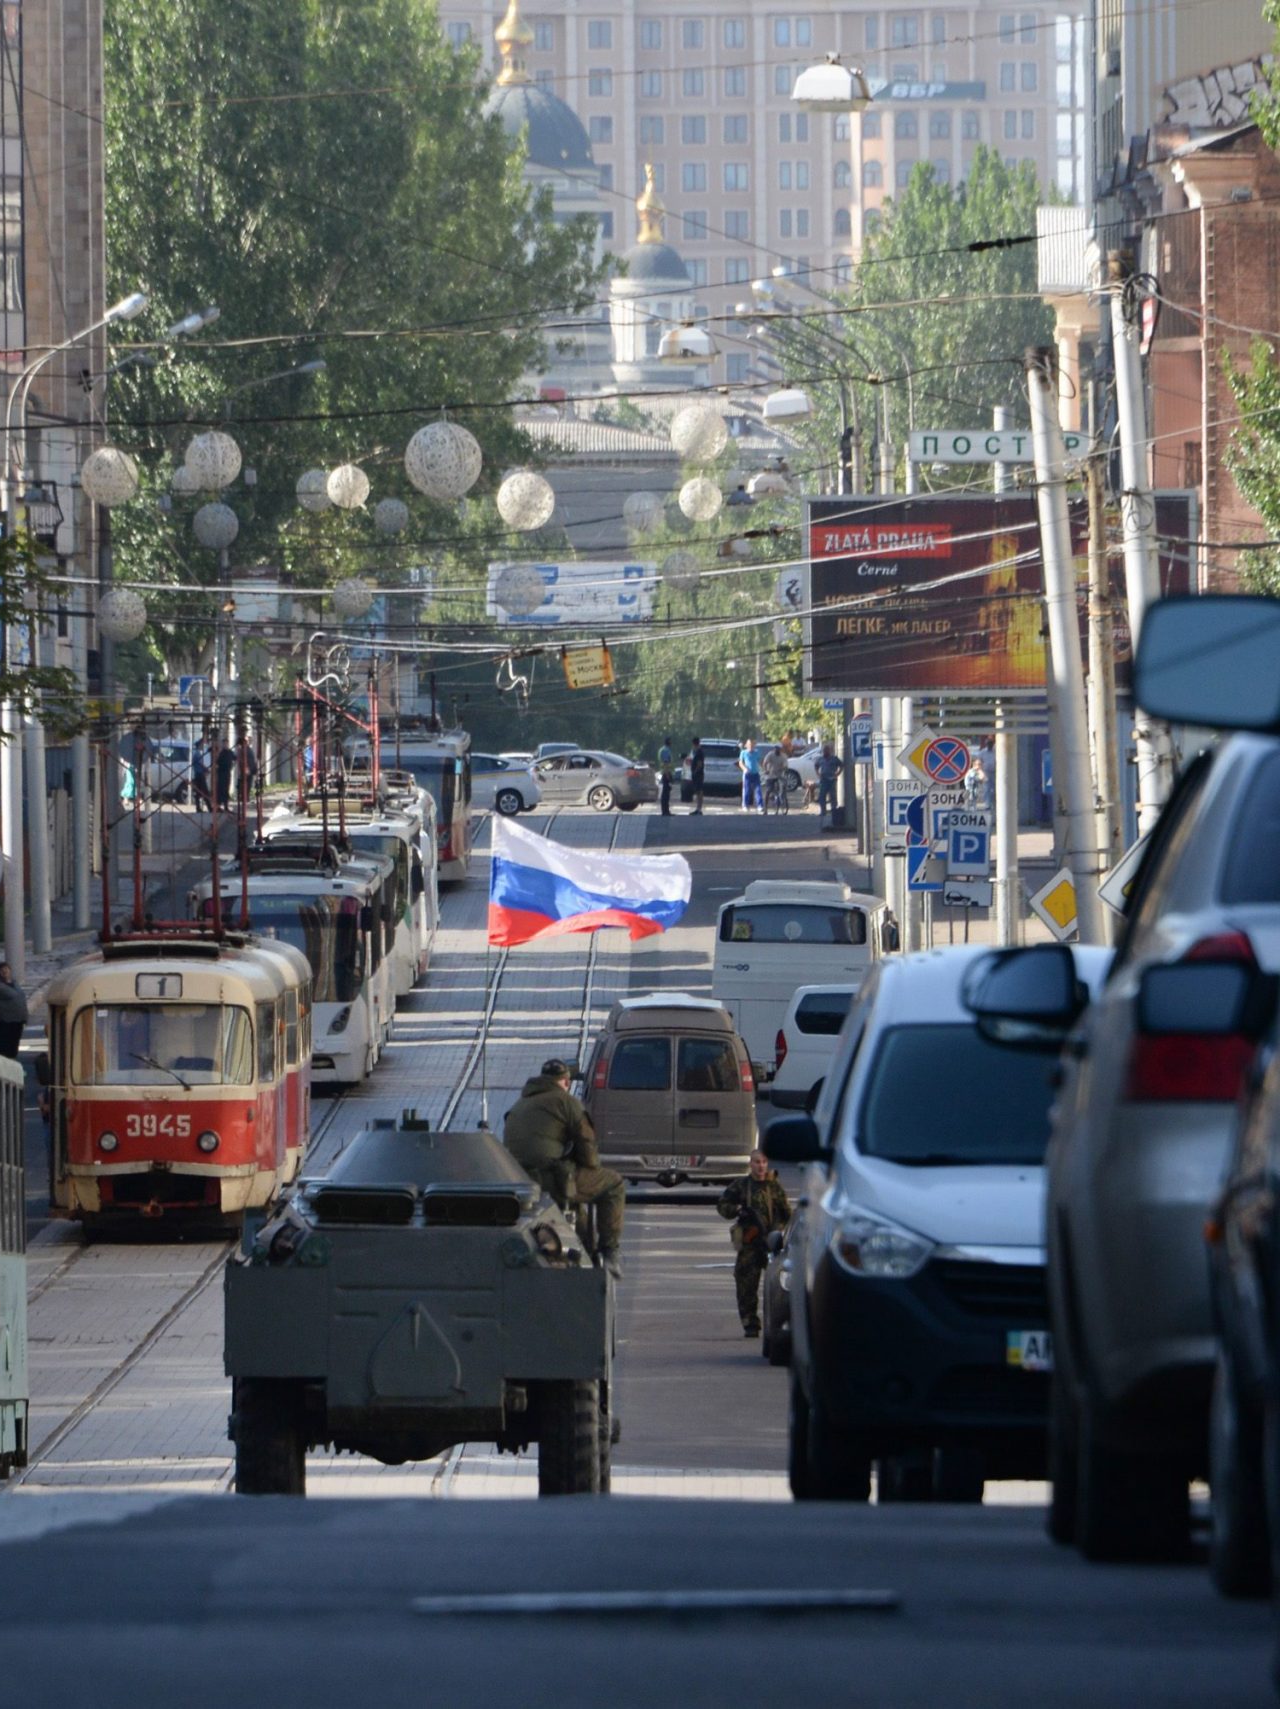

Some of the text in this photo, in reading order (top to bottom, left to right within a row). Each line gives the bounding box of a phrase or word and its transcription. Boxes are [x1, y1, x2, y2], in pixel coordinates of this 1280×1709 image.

[923, 436, 1080, 455] ПОСТР
[857, 562, 898, 576] Černé
[889, 781, 919, 792] ЗОНА
[932, 794, 965, 805] ЗОНА
[951, 815, 987, 826] ЗОНА
[157, 978, 167, 996] 1
[127, 1114, 191, 1137] 3945
